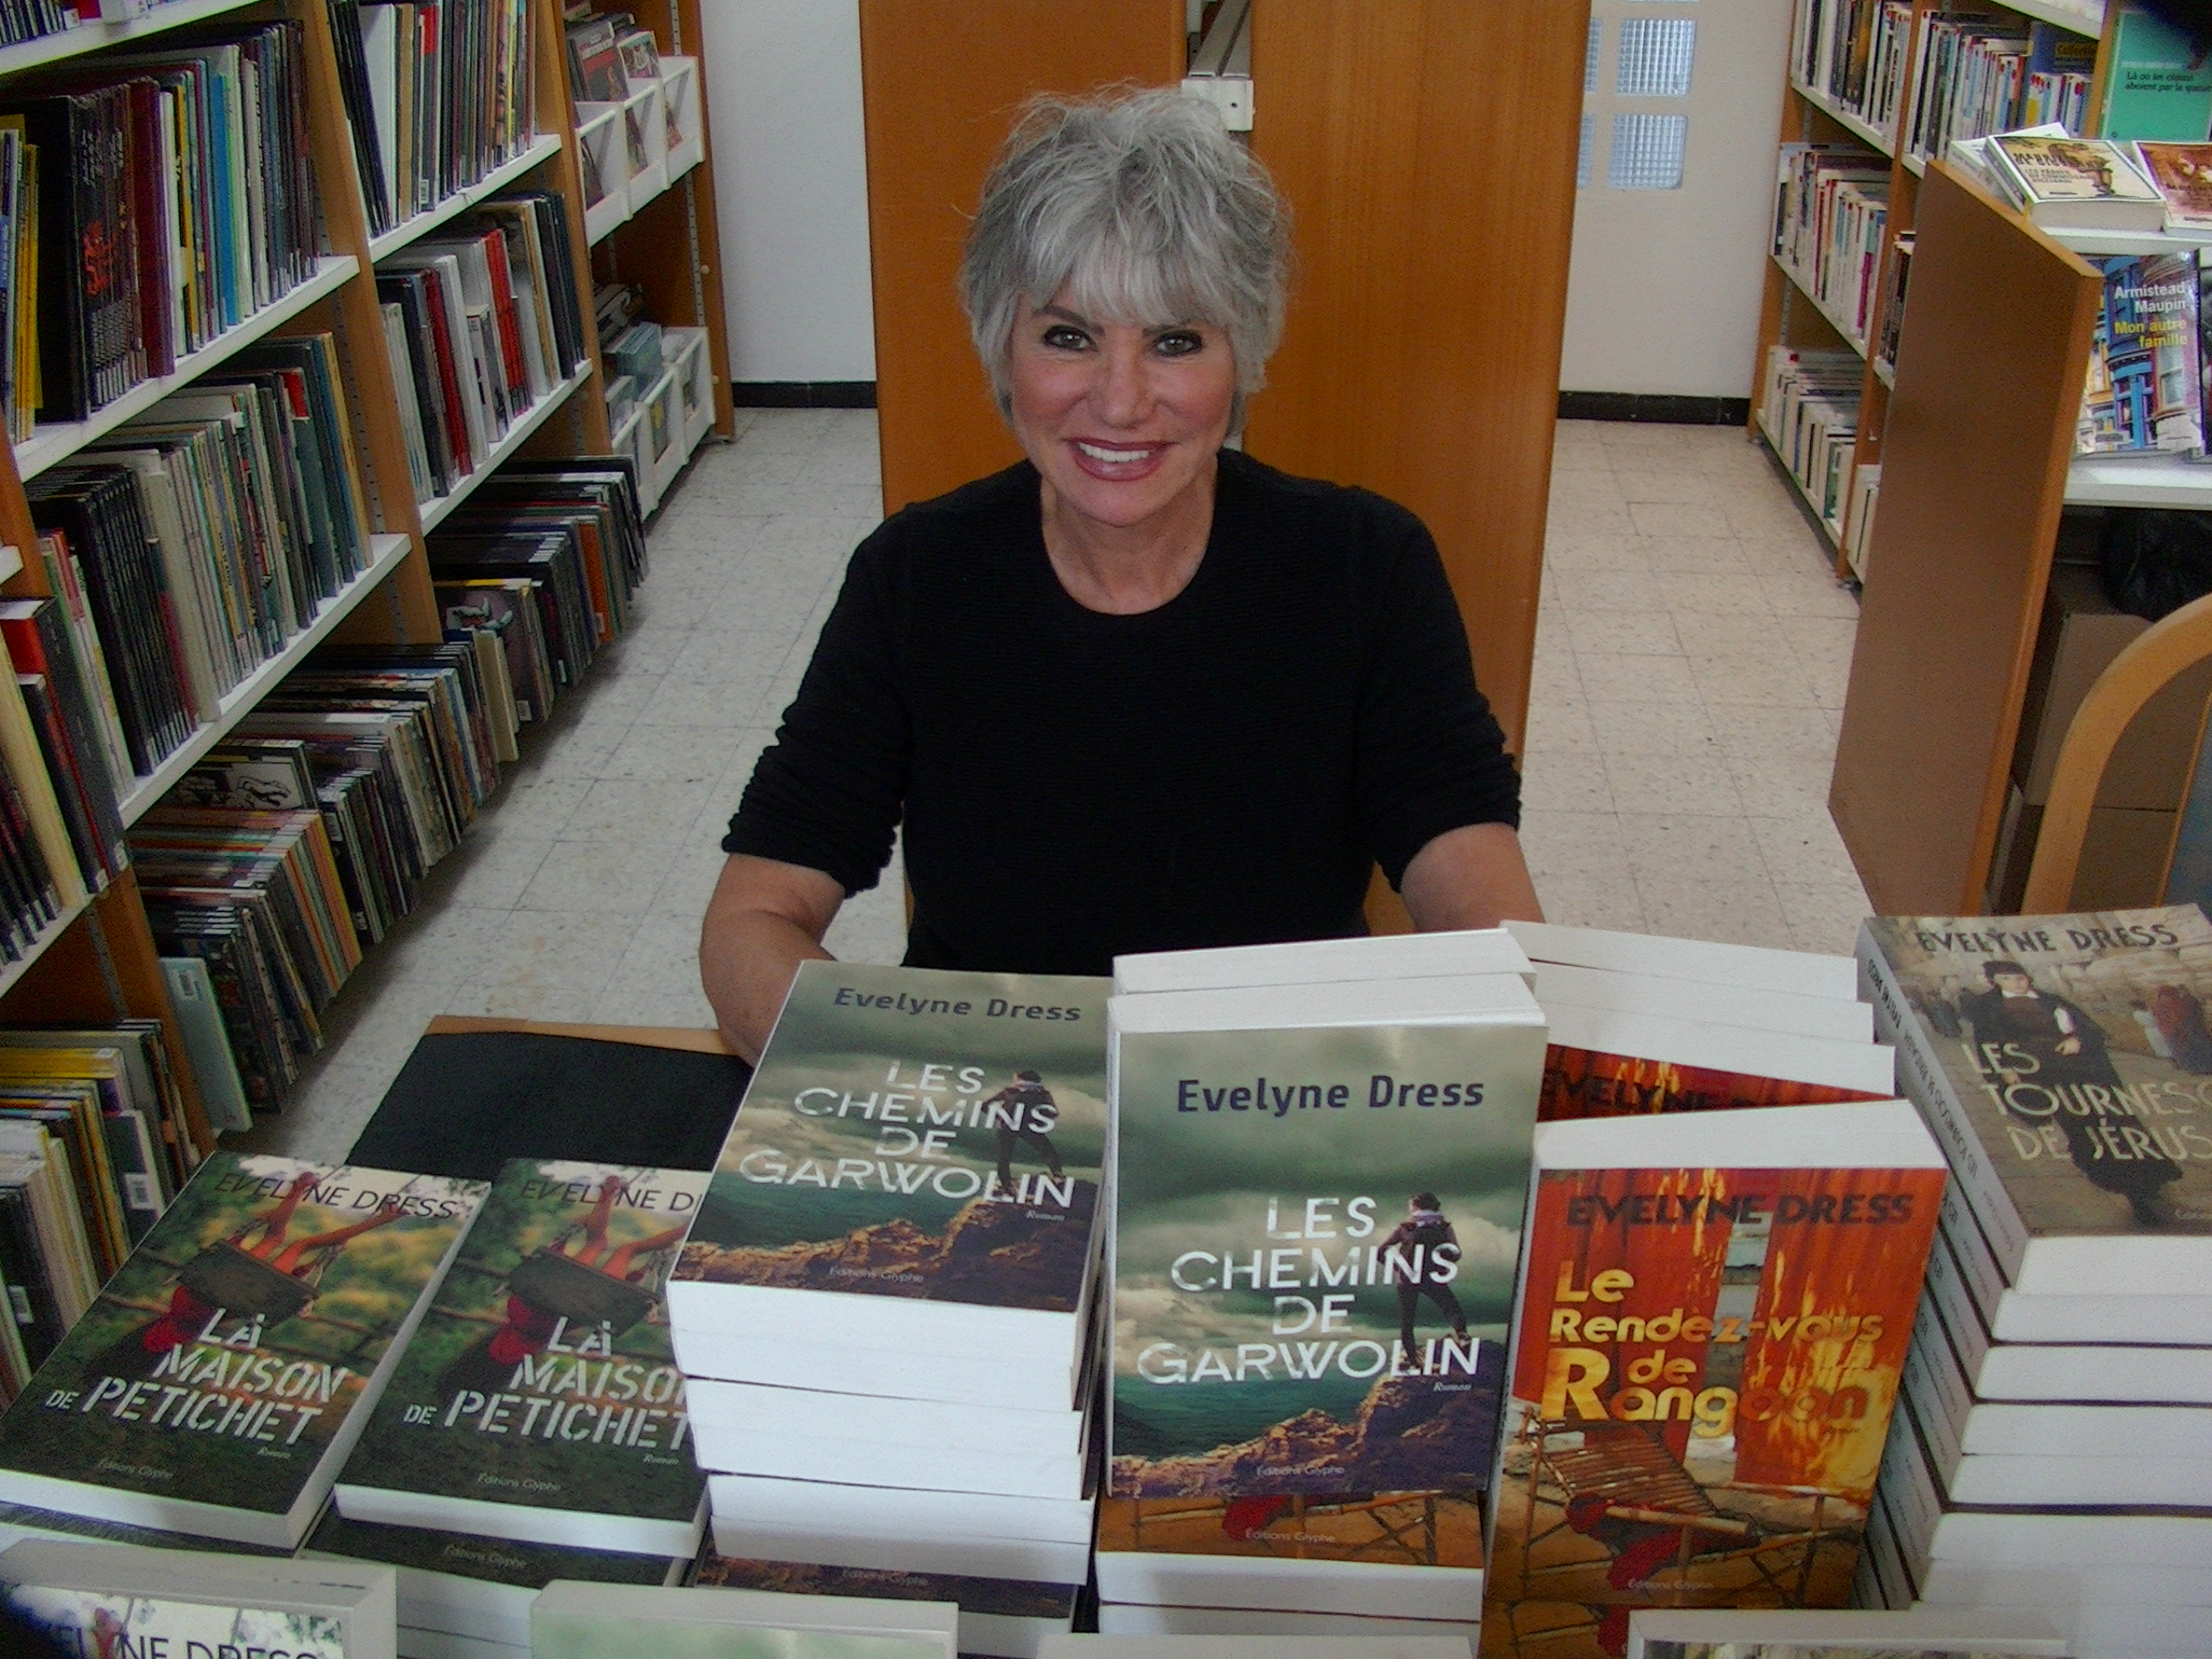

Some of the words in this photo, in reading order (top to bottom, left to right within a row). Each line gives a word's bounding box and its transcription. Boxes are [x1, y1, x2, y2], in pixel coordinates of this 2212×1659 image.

[2115, 281, 2186, 300] Armistead
[2135, 299, 2186, 316] Maupin
[2115, 320, 2145, 335] Mon
[2150, 318, 2187, 332] autre
[2139, 333, 2188, 349] famille
[1914, 927, 2056, 954] EVELYNE
[2065, 924, 2179, 951] DRESS
[834, 987, 972, 1016] Evelyne
[987, 998, 1082, 1022] Dress
[1961, 1042, 2041, 1075] LES
[885, 1061, 985, 1094] LES
[794, 1087, 1058, 1134] CHEMINS
[1177, 1077, 1350, 1117] Evelyne
[1368, 1075, 1485, 1108] Dress
[1980, 1082, 2212, 1117] TOURNES
[874, 1126, 958, 1160] DE
[2005, 1126, 2071, 1160] DE
[739, 1149, 1075, 1208] GARWOLIN
[353, 1190, 459, 1220] DRESS
[1025, 1210, 1066, 1222] Roman
[1265, 1196, 1377, 1240] LES
[1567, 1193, 1767, 1226] EVELYNE
[1774, 1192, 1914, 1225] DRESS
[1170, 1243, 1463, 1292] CHEMINS
[1555, 1260, 1635, 1302] Le
[197, 1308, 266, 1350] LA
[1272, 1294, 1357, 1336] DE
[1549, 1308, 1884, 1343] Rendez-vous
[545, 1316, 613, 1357] LA
[152, 1343, 351, 1404] MAISON
[1137, 1337, 1481, 1385] GARWOLIN
[1627, 1349, 1697, 1384] de
[510, 1353, 686, 1404] MAISO
[1432, 1381, 1473, 1393] Roman
[1540, 1347, 1870, 1439] Rangoon
[45, 1389, 79, 1412] DE
[82, 1375, 324, 1446] PETICHET
[402, 1404, 438, 1426] DE
[643, 1453, 679, 1466] Roman
[1305, 1465, 1346, 1478] Glyphe
[522, 1478, 562, 1492] Glyphe
[1295, 1532, 1336, 1544] Glyphe
